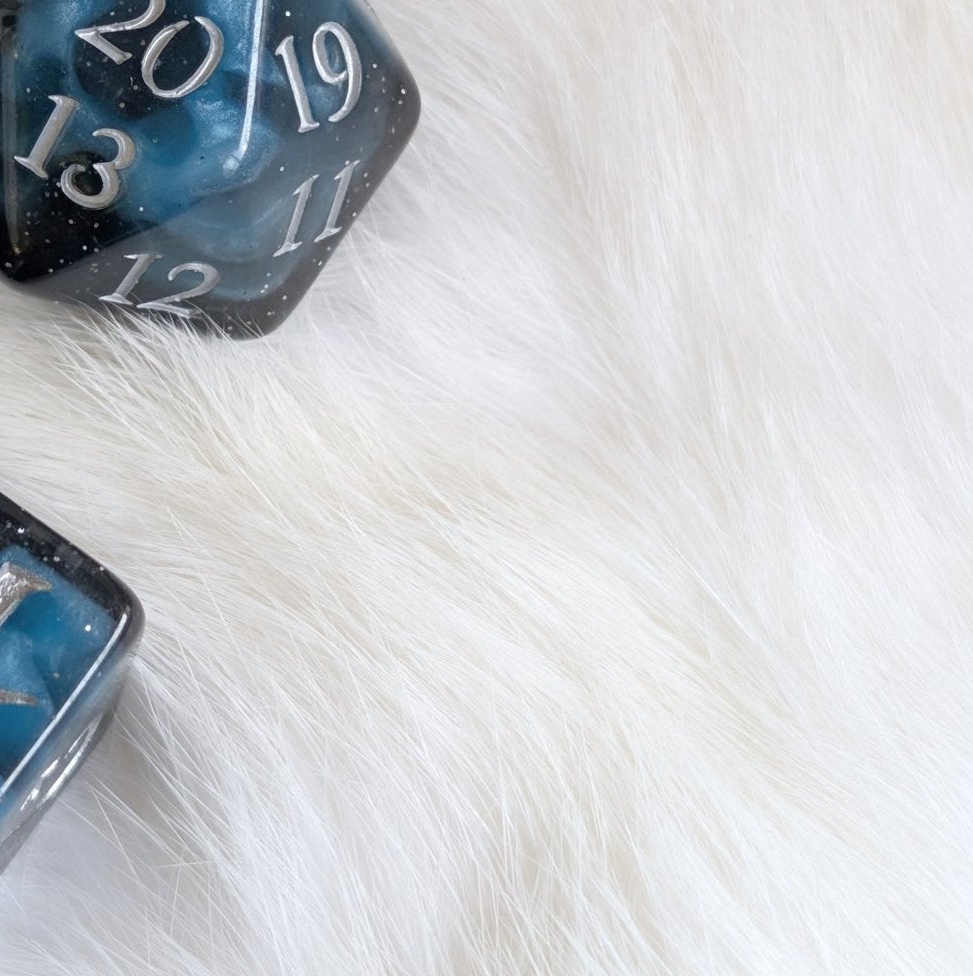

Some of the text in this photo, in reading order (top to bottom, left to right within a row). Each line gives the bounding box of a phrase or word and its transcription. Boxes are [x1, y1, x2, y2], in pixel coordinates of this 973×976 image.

[274, 20, 364, 134] 19
[13, 93, 137, 211] 13
[272, 158, 362, 258] 11
[98, 252, 223, 319] 12
